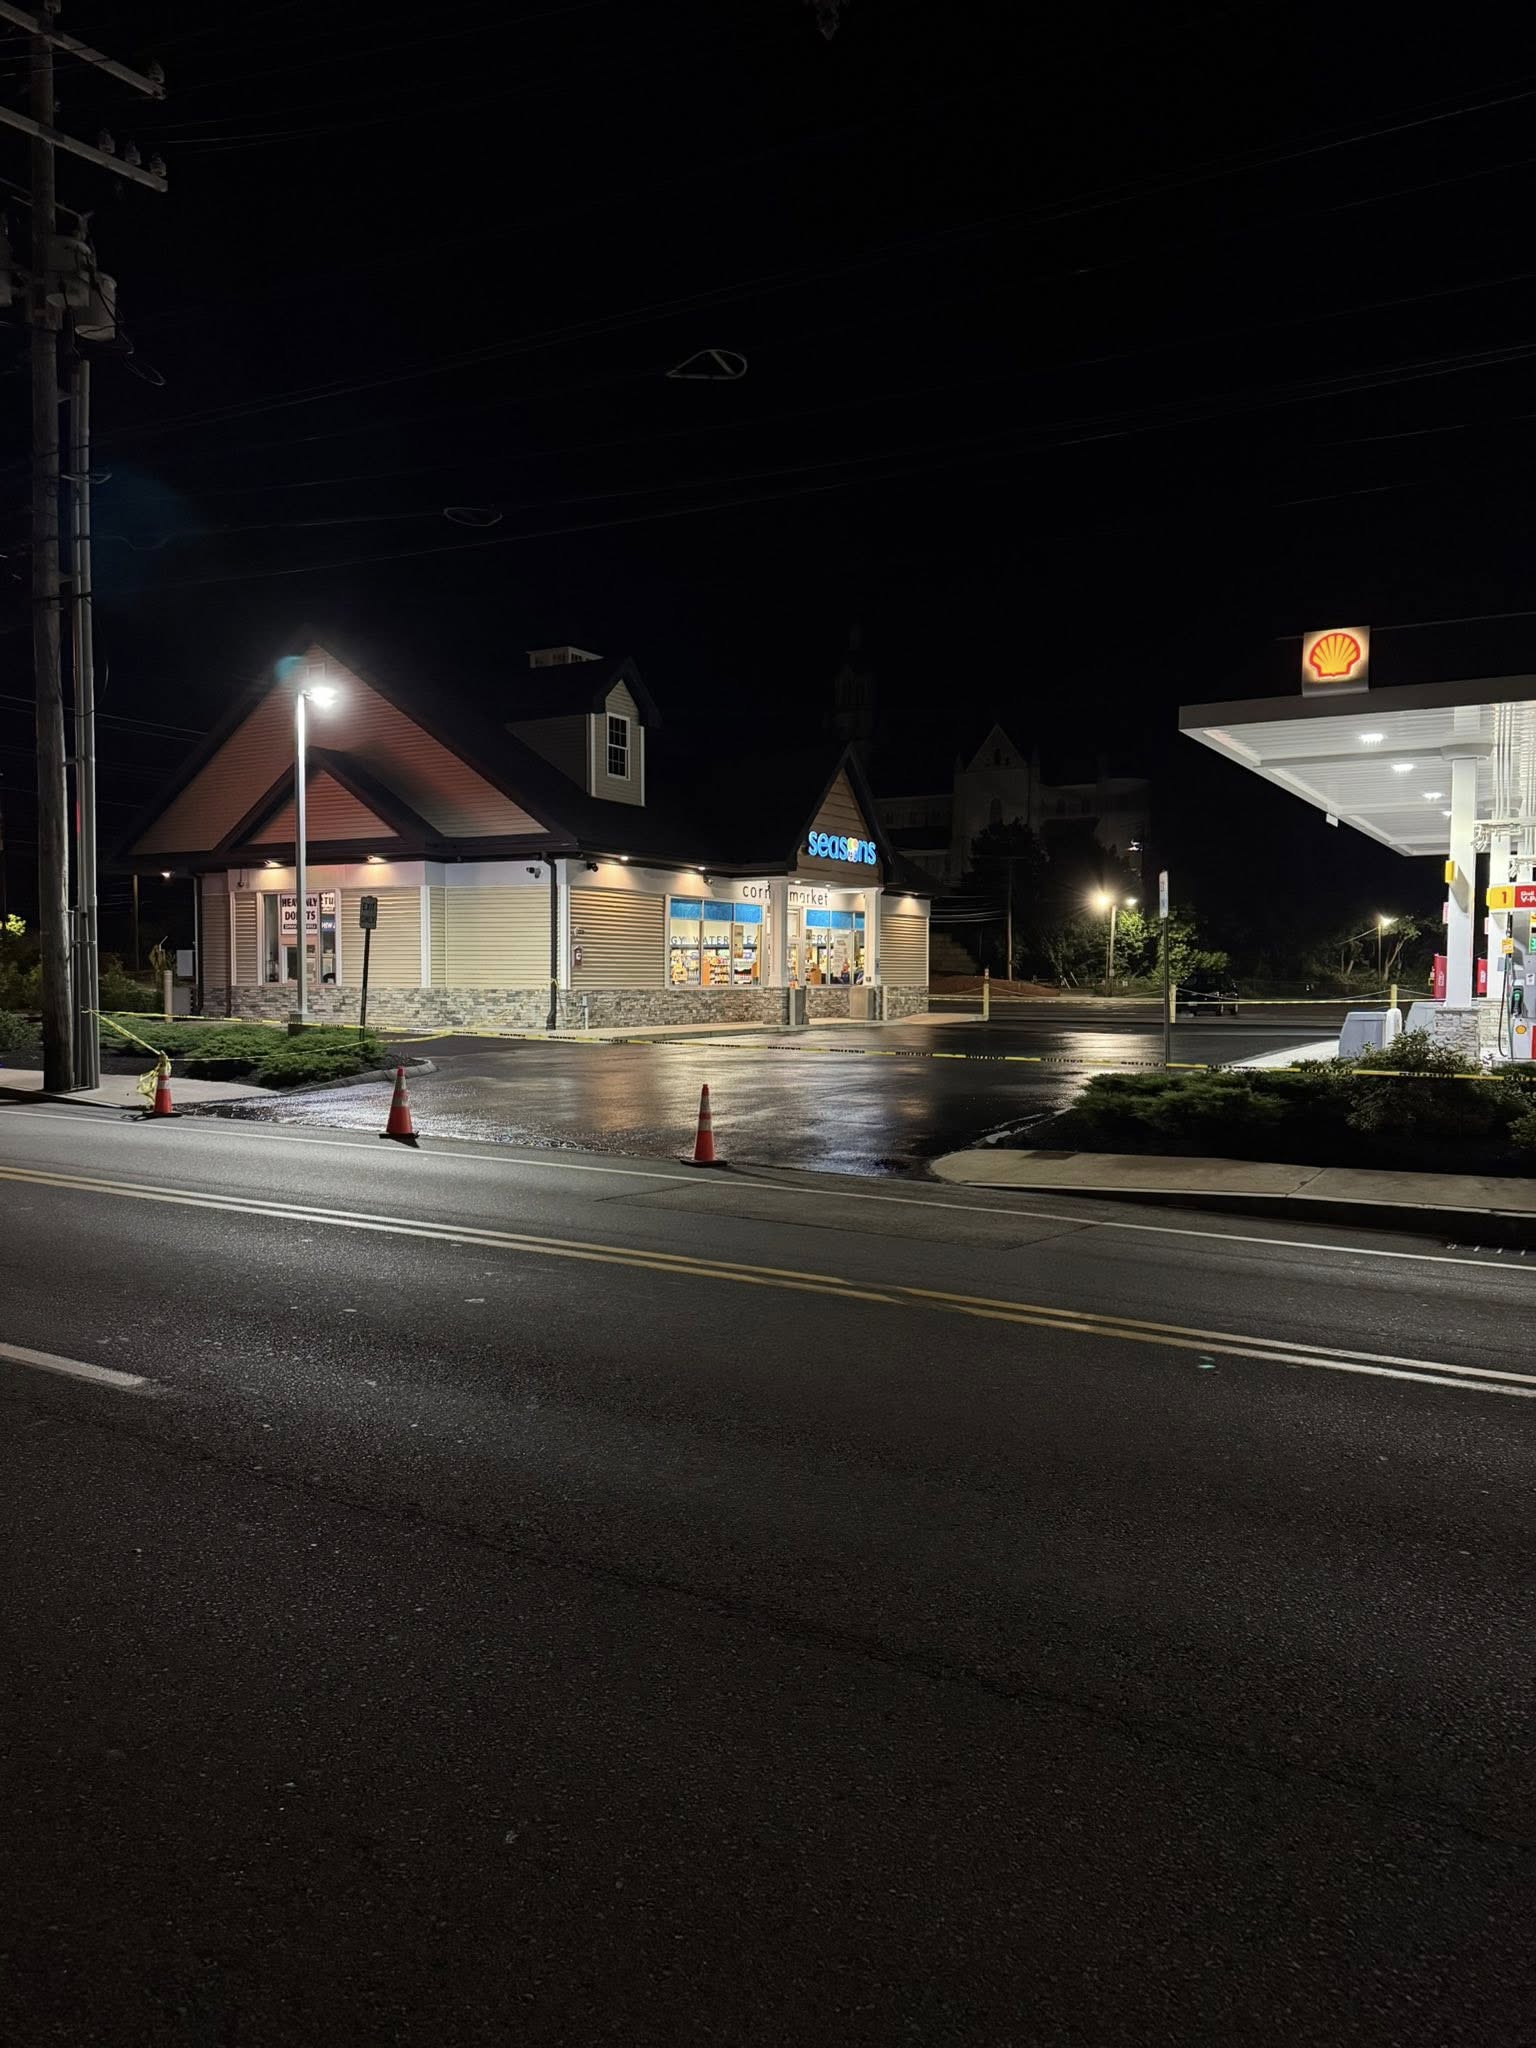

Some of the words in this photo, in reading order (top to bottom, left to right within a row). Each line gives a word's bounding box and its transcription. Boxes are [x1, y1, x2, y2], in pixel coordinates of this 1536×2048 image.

[808, 831, 878, 865] seasons
[742, 886, 771, 899] corn
[790, 888, 829, 906] market
[1502, 891, 1507, 904] 1
[1520, 895, 1536, 904] V-P
[282, 897, 317, 907] HEANLY
[285, 911, 316, 921] DOTS
